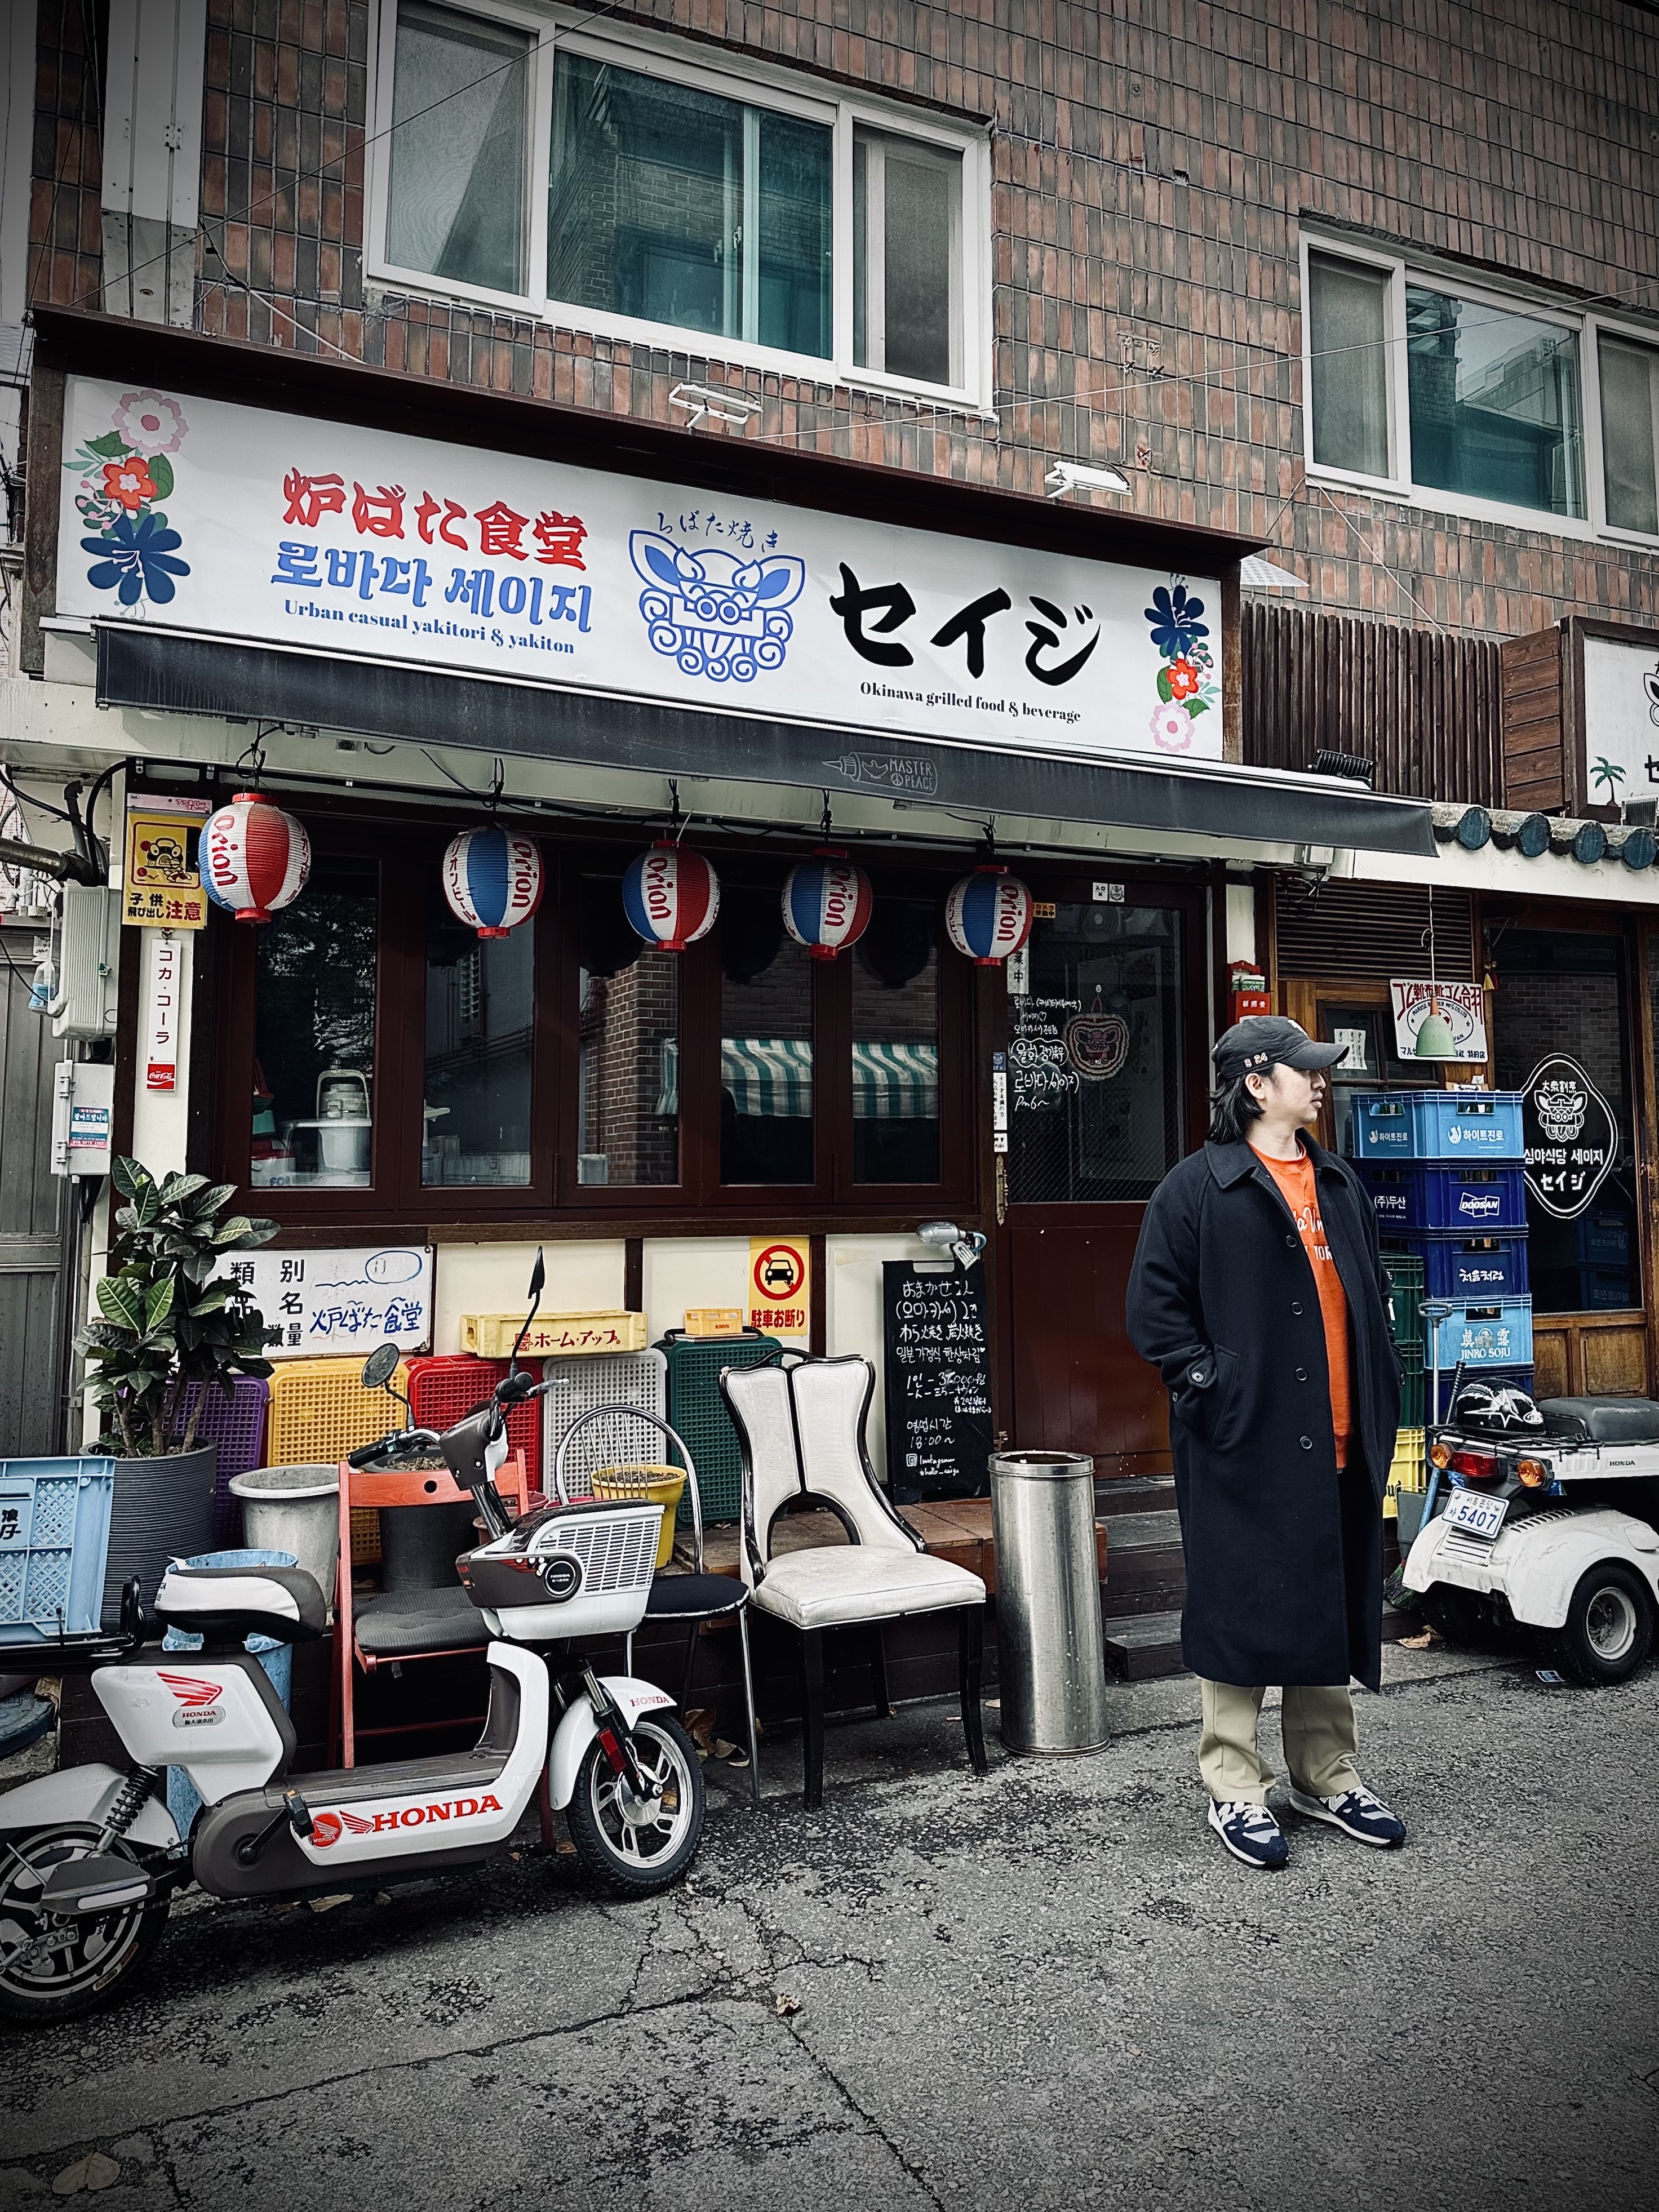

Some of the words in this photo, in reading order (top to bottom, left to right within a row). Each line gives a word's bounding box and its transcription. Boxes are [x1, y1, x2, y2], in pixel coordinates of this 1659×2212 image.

[282, 467, 588, 571] 炉ばた食堂
[270, 541, 432, 607] 로바다
[445, 568, 592, 633] 세이지
[284, 599, 344, 621] Urban
[348, 611, 408, 630] casual
[411, 619, 486, 641] yakitori
[490, 628, 504, 647] &
[508, 632, 575, 654] yakiton
[829, 562, 1101, 686] セイジ
[860, 681, 924, 702] Okinawa
[926, 691, 972, 708] grilled
[976, 696, 1005, 712] food
[1008, 701, 1019, 717] &
[1023, 703, 1081, 725] beverage
[890, 758, 933, 776] MASTER
[904, 775, 934, 790] PEACE
[211, 815, 238, 886] Orion
[512, 841, 538, 908] Orion
[647, 857, 674, 920] Orion
[824, 865, 854, 927] Orion
[130, 892, 163, 907] 子供
[127, 906, 165, 918] 飛び出し
[166, 900, 201, 921] 注意
[996, 885, 1022, 941] Orion
[156, 950, 172, 1044] コカ・コーラ
[1253, 1052, 1268, 1064] 24
[1379, 1132, 1408, 1141] 하이트진로
[1463, 1129, 1504, 1142] 하이트진로
[1524, 1148, 1567, 1165] 심야식당
[1571, 1148, 1603, 1165] 세이지
[1541, 1171, 1586, 1192] セイジ
[1374, 1195, 1407, 1210] (주)두산
[1461, 1200, 1498, 1210] DOOSAN
[1313, 1245, 1333, 1260] YOR
[1459, 1268, 1505, 1282] 처음처럼
[902, 1280, 952, 1298] おまかせ
[309, 1300, 423, 1335] 炉ばた食堂
[751, 1308, 805, 1329] 駐車お断り
[534, 1329, 618, 1348] ホーム・アップ
[896, 1345, 916, 1363] 일본
[915, 1345, 941, 1363] 가정식
[943, 1345, 981, 1363] 한상차림
[1488, 1347, 1511, 1358] SOJU
[907, 1416, 952, 1434] 영업시간
[1458, 1505, 1497, 1530] 5407
[629, 1696, 670, 1707] HONDA
[372, 1795, 503, 1833] HONDA
[313, 1835, 336, 1843] HONDA
